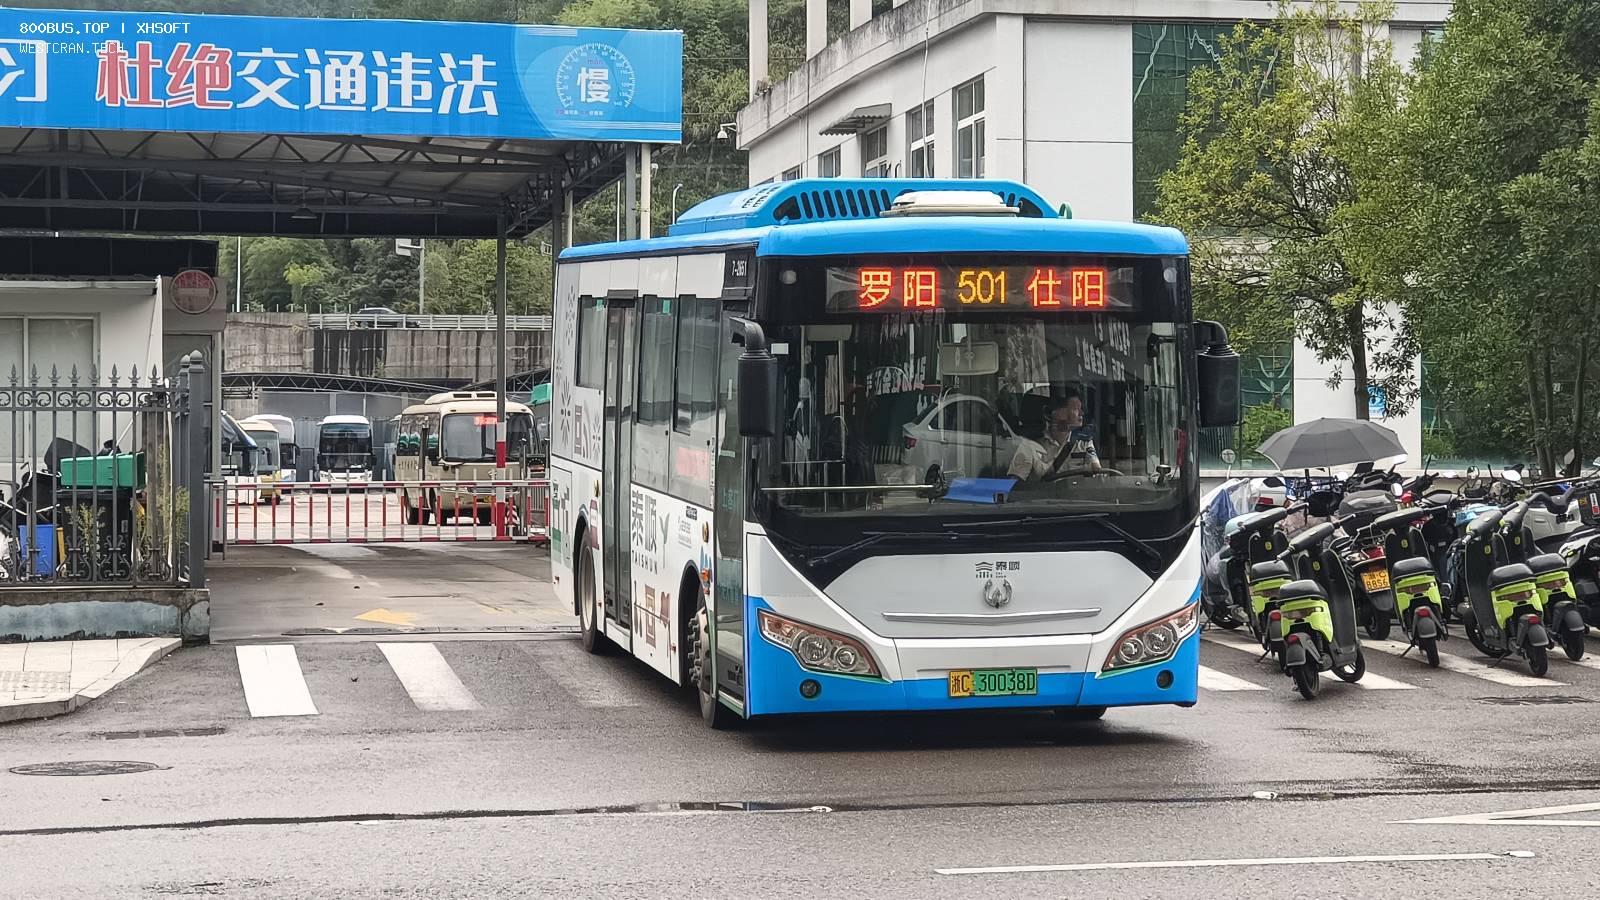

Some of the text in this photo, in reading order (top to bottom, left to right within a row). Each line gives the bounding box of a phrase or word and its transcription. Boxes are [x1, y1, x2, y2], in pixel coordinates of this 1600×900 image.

[96, 40, 498, 116] 杜绝交通违法
[577, 67, 612, 103] 慢
[858, 268, 1105, 307] 罗阳 501 仕阳
